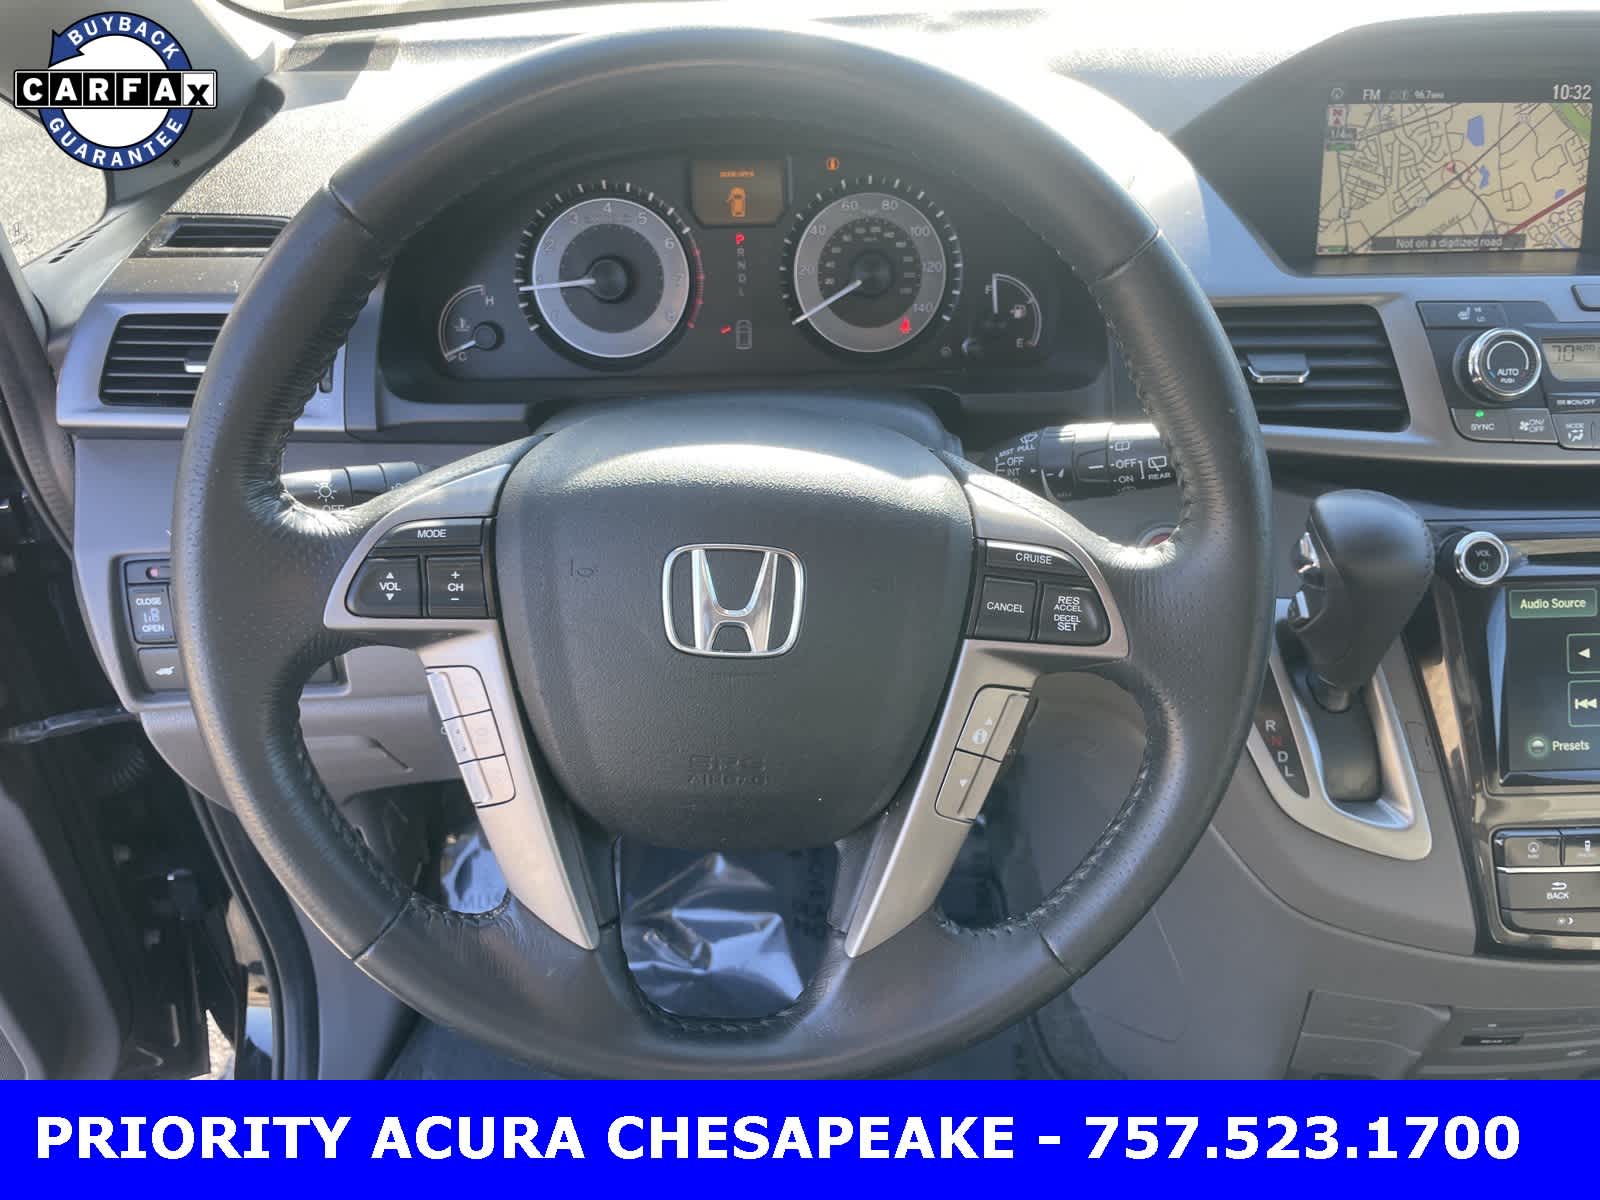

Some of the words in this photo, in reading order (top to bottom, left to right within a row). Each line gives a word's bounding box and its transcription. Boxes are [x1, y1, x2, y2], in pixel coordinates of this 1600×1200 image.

[1363, 90, 1381, 100] FM
[1553, 84, 1592, 100] 10:32
[603, 203, 612, 214] 4
[841, 199, 858, 210] 60
[881, 199, 898, 210] 80
[809, 225, 827, 237] 40
[910, 226, 931, 237] 100
[735, 233, 744, 245] P
[1396, 237, 1412, 249] Not
[1414, 240, 1427, 248] on
[1430, 240, 1436, 248] a
[1480, 235, 1503, 248] road
[922, 261, 943, 273] 120
[913, 303, 934, 314] 140
[1497, 368, 1519, 377] AUTO
[1471, 423, 1495, 432] SYNC
[1007, 456, 1024, 466] OFF
[1115, 458, 1137, 469] OFF
[1118, 474, 1134, 483] ON
[1148, 472, 1171, 480] REAR
[417, 529, 447, 538] MODE
[1015, 552, 1053, 565] CRUISE
[379, 582, 401, 591] VOL
[447, 583, 464, 592] CH
[136, 597, 162, 605] CLOSE
[1057, 595, 1080, 605] RES
[1520, 598, 1549, 609] Audio
[1552, 597, 1587, 608] Source
[986, 601, 1025, 614] CANCEL
[1053, 614, 1081, 623] DECEL
[142, 624, 164, 632] OPEN
[1056, 622, 1079, 632] SET
[1265, 720, 1276, 731] R
[1552, 741, 1590, 752] Presets
[1278, 752, 1288, 762] D
[1285, 766, 1294, 776] L
[1546, 892, 1569, 900] BACK
